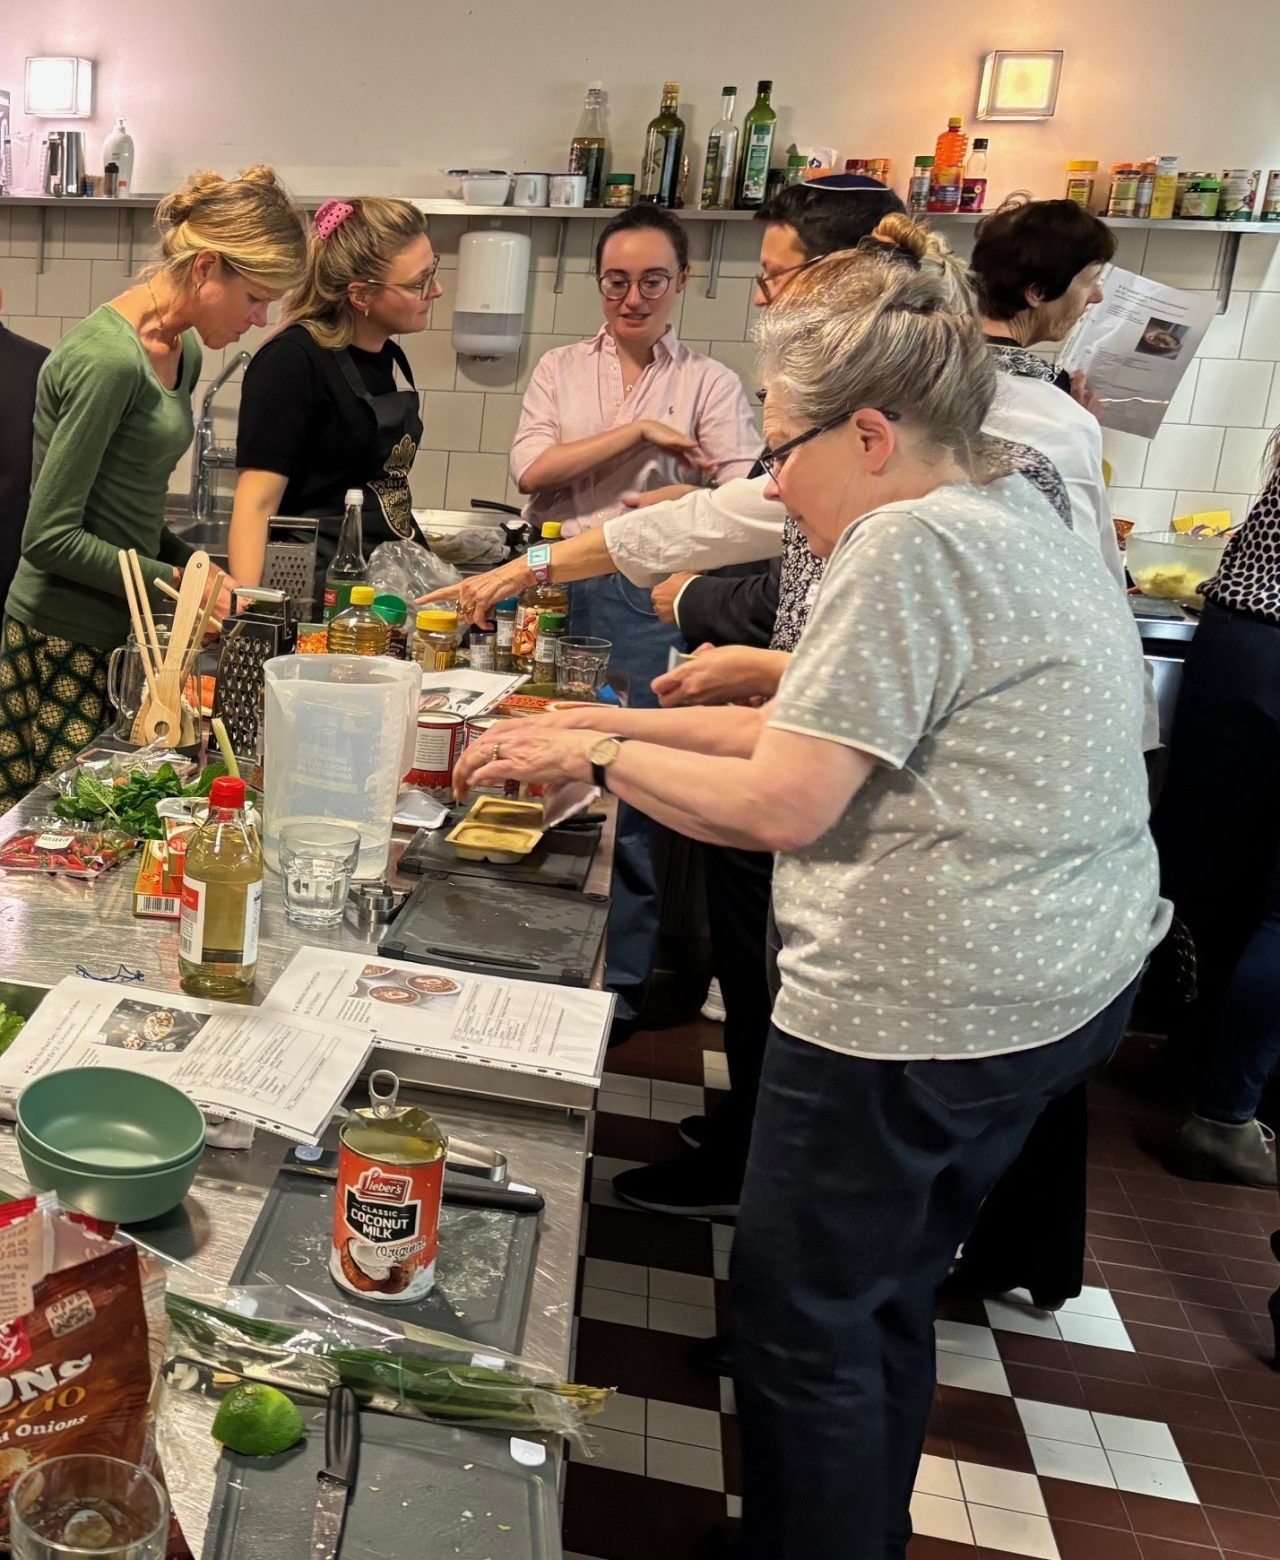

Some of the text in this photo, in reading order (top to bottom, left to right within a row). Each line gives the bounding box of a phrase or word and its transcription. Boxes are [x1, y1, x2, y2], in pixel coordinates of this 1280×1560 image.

[363, 1170, 403, 1195] Lieber's
[350, 1208, 410, 1230] COCONUT
[361, 1204, 399, 1218] CLASSIC
[362, 1223, 393, 1239] MILK
[375, 1235, 427, 1260] Original
[15, 1414, 89, 1438] Onions
